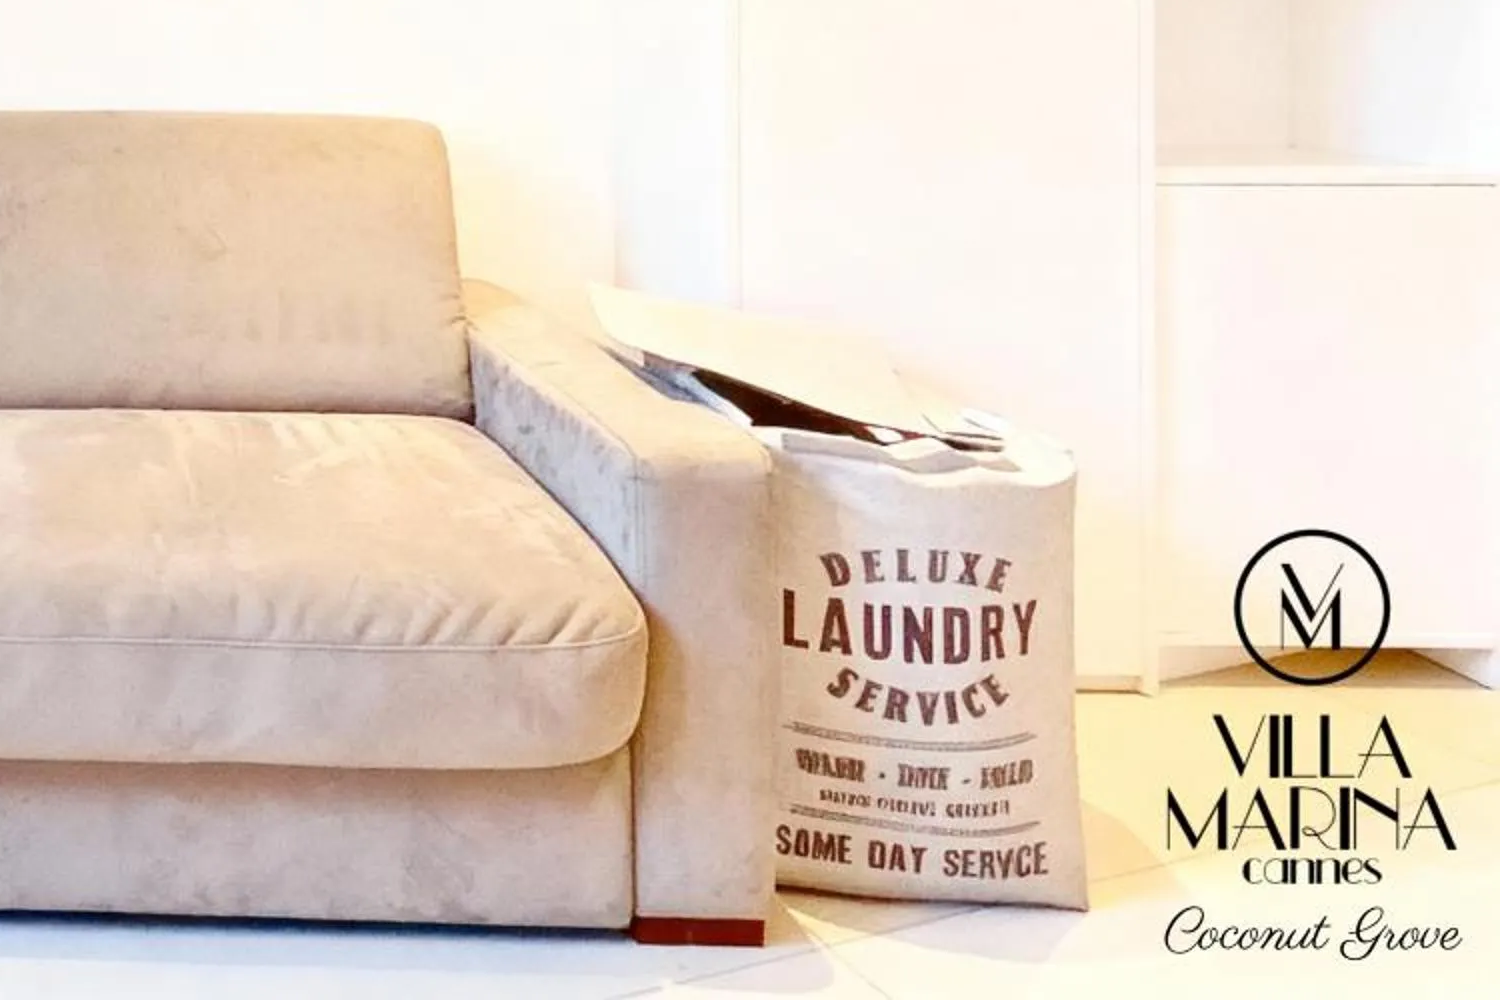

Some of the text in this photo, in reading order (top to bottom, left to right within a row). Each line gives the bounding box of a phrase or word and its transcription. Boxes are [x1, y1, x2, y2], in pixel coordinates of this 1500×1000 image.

[819, 548, 1012, 593] DELUXE
[781, 587, 1037, 665] LAUNDRY
[826, 667, 1010, 727] SERVICE
[867, 839, 928, 875] DAY
